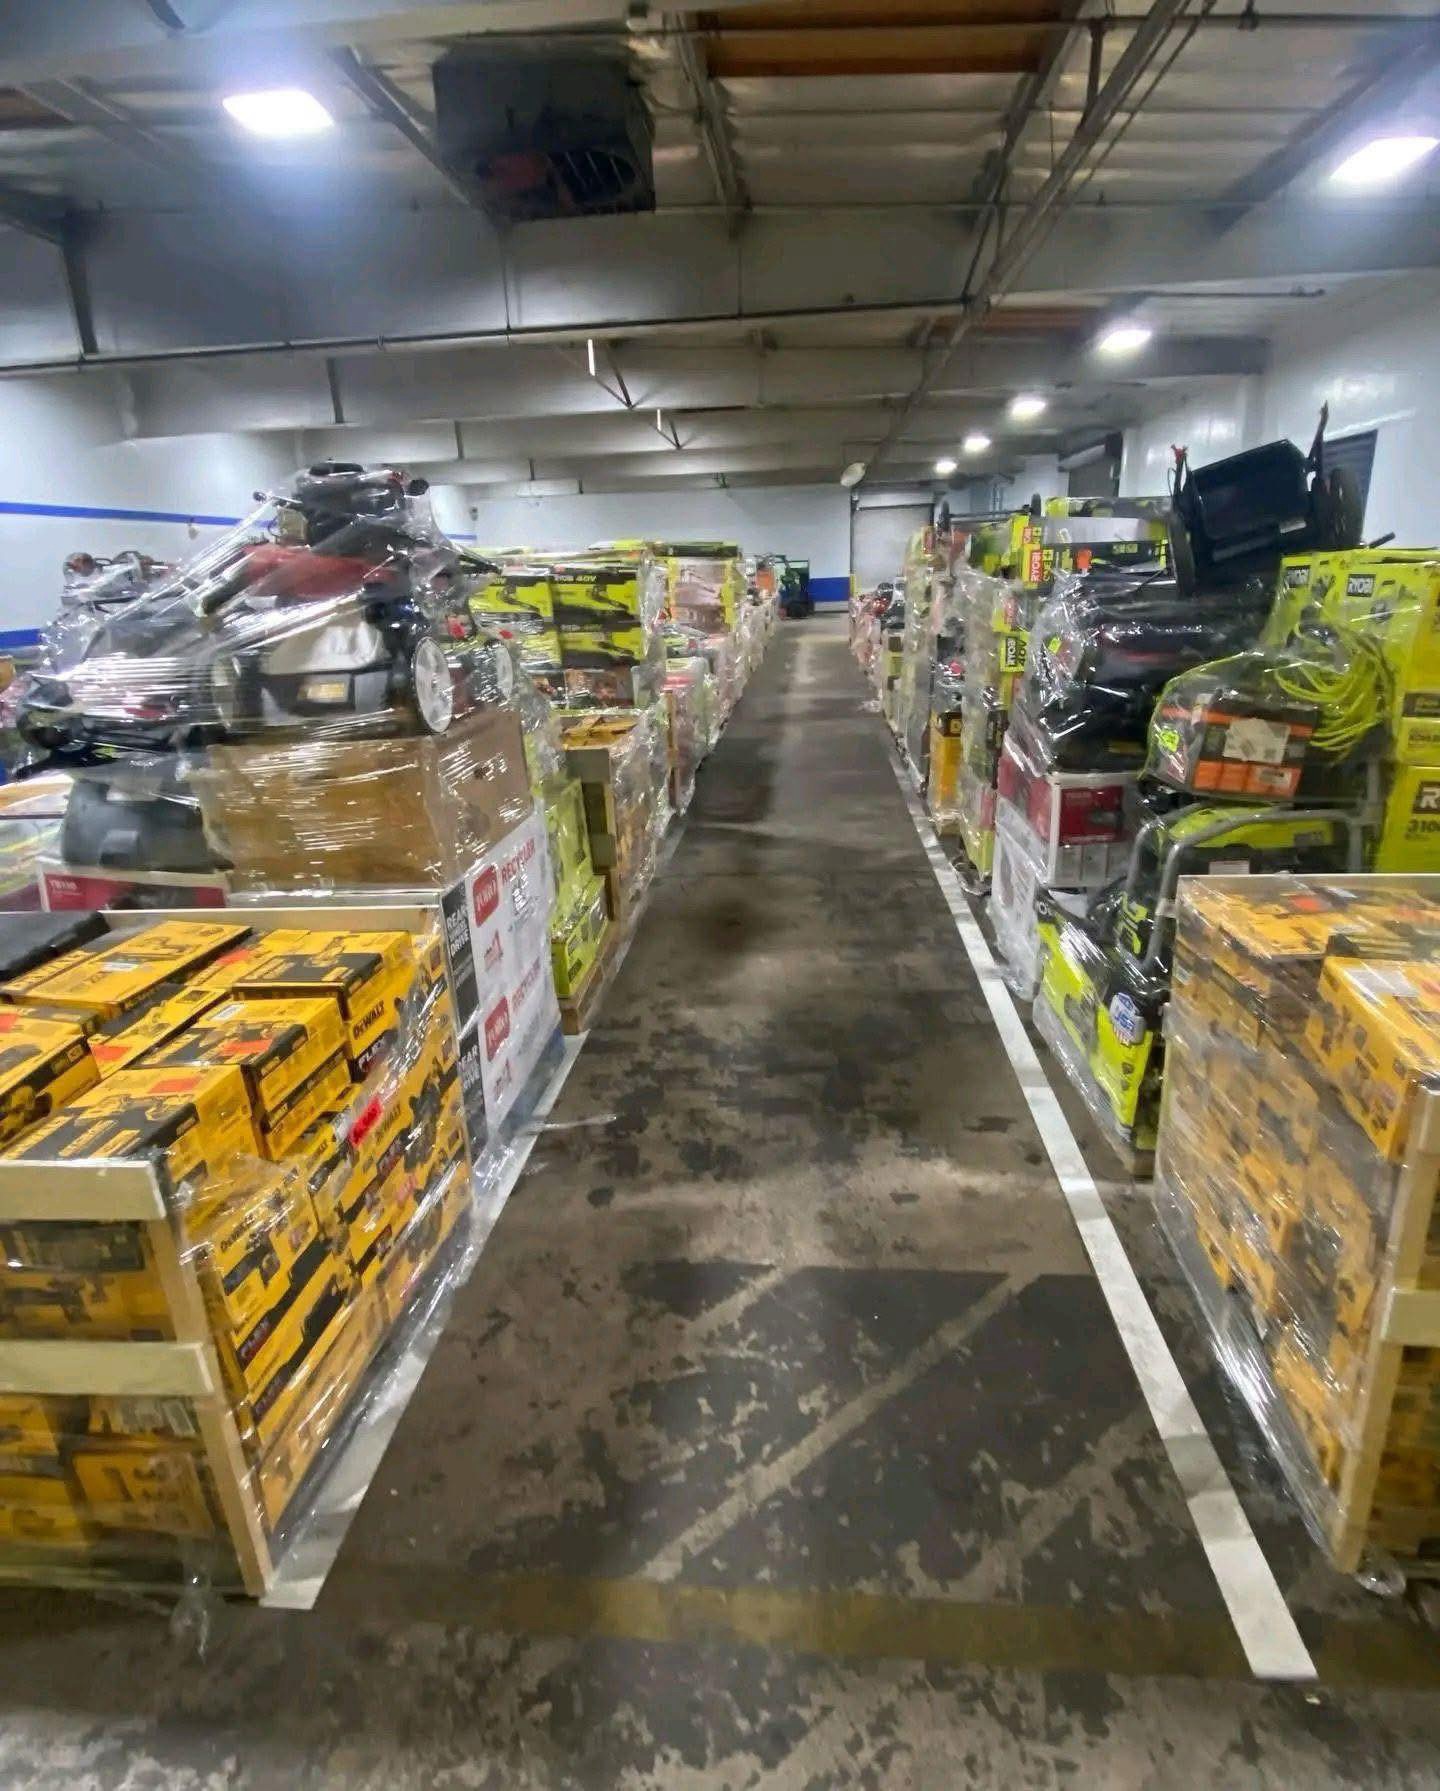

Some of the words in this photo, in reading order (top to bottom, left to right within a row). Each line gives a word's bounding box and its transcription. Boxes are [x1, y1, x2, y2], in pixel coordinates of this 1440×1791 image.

[576, 575, 597, 583] 40V
[1347, 577, 1374, 594] RYOBI
[1007, 637, 1016, 666] RYOBI
[1018, 640, 1027, 666] 40V
